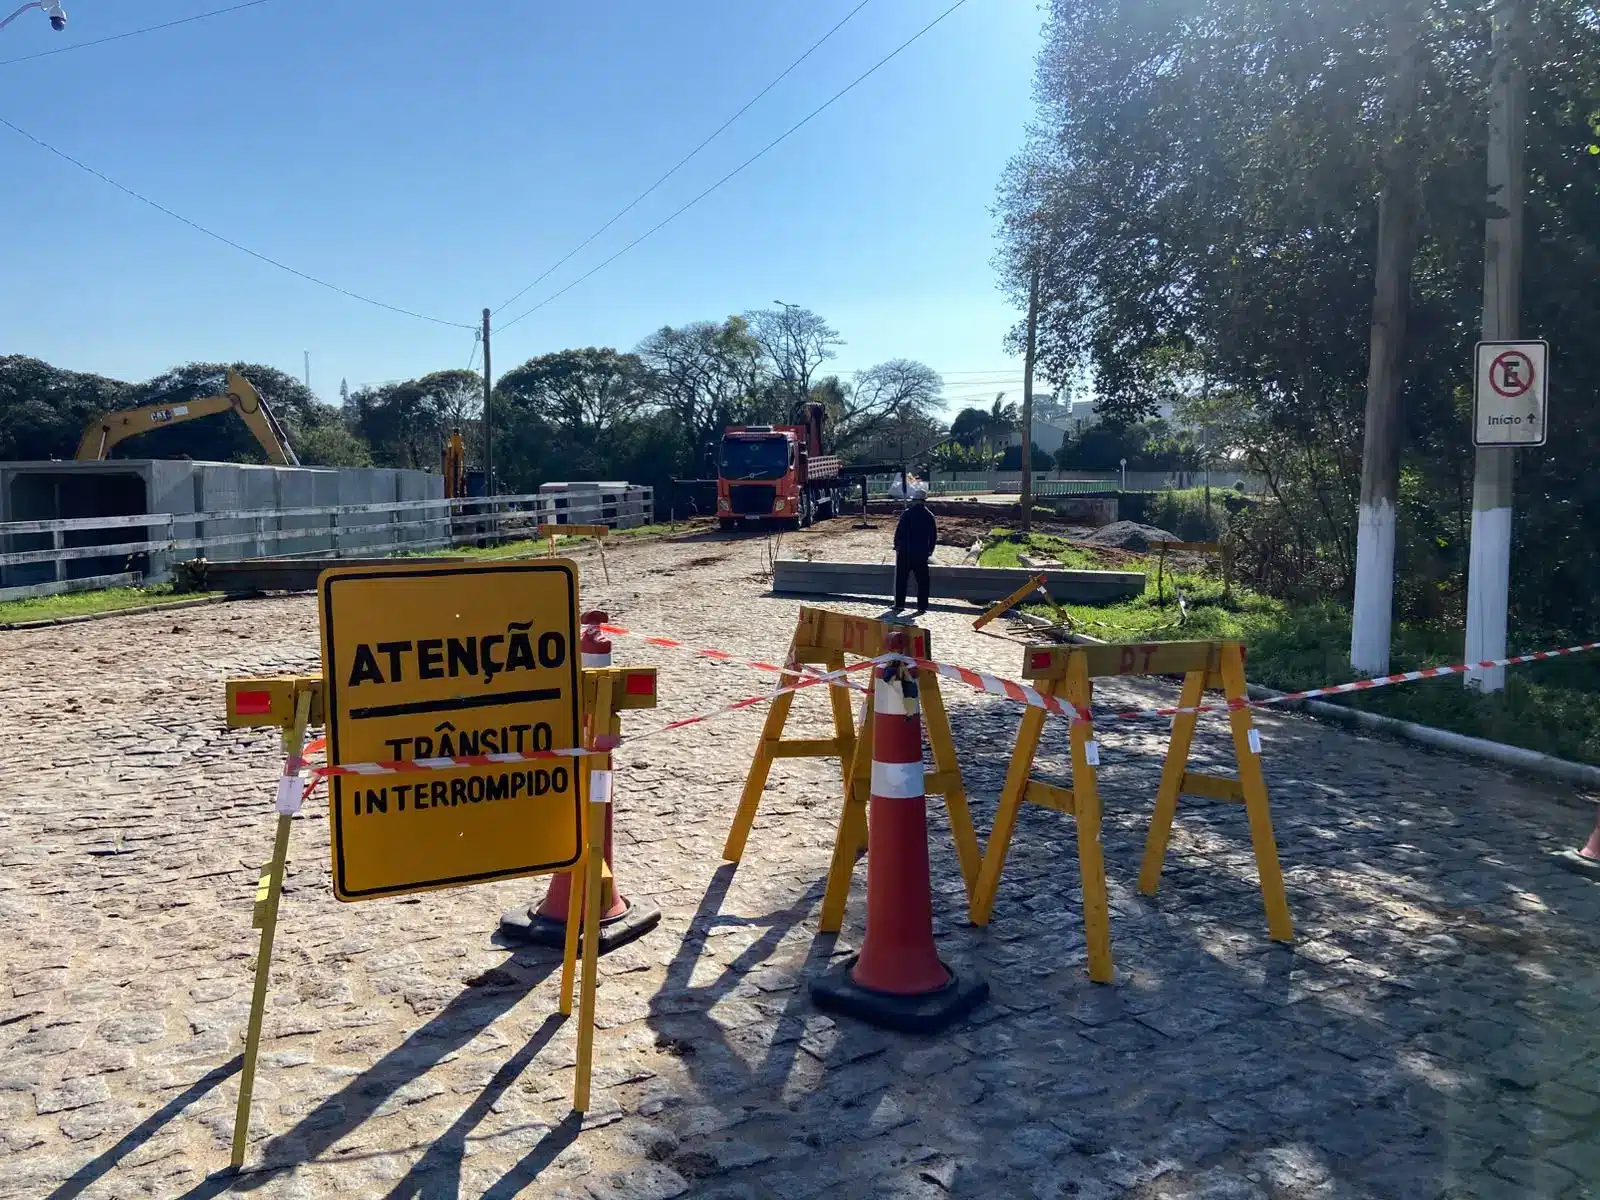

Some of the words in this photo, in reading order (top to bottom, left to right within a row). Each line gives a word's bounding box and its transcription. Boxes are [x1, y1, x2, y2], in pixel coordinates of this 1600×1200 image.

[151, 410, 168, 421] CAT
[348, 620, 566, 687] ATENÇÃO
[1120, 645, 1160, 674] DT
[384, 721, 553, 761] TRÂNSITO
[354, 767, 569, 816] INTERROMPIDO
